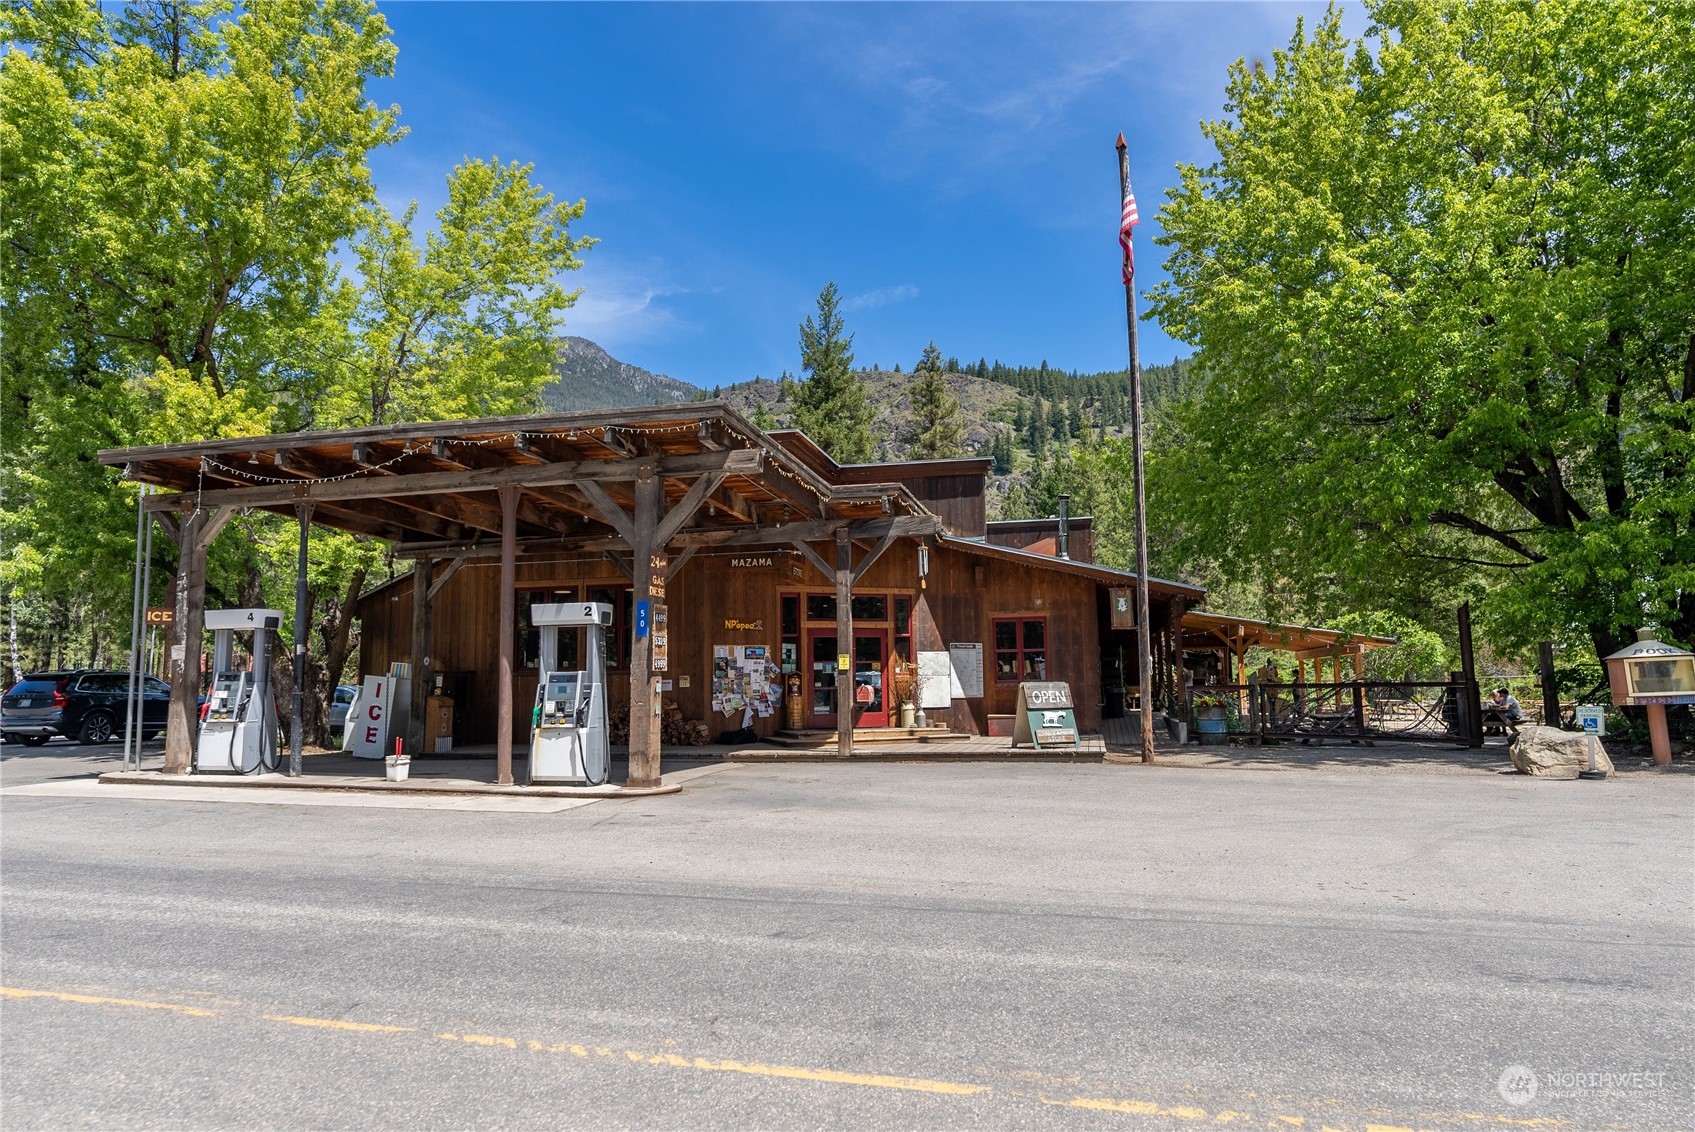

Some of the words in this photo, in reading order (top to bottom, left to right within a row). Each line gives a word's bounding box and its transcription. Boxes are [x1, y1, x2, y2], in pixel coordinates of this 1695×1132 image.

[731, 558, 773, 568] MAZAMA
[652, 575, 665, 586] GAS
[147, 611, 173, 621] ICE
[584, 606, 592, 616] 2
[247, 612, 254, 622] 4
[1032, 690, 1067, 704] OPEN
[365, 682, 382, 744] ICE
